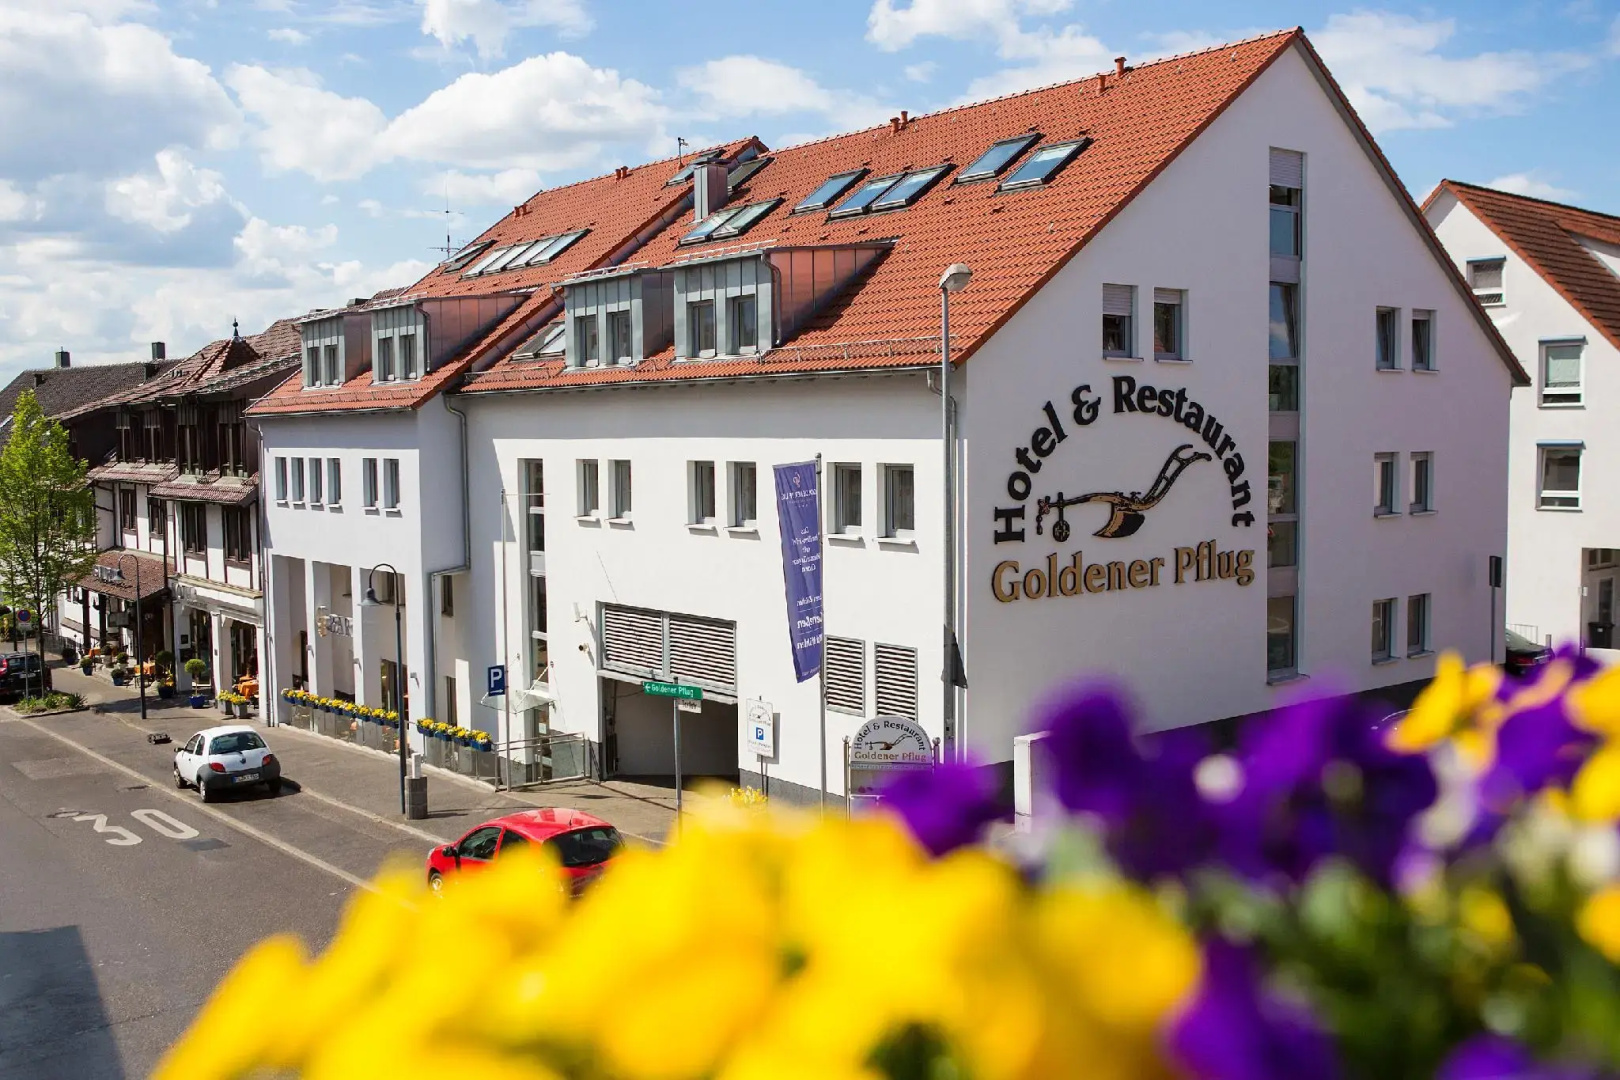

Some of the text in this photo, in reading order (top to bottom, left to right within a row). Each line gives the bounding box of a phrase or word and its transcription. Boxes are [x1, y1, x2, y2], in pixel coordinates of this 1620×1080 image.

[994, 375, 1255, 545] Hotel & Restaurant
[992, 539, 1255, 603] Goldener Pflug
[490, 668, 503, 688] P
[651, 684, 694, 698] Goldener Pflug
[757, 728, 763, 739] P
[854, 720, 926, 751] Hotel & Restaurant
[854, 751, 927, 763] Goldener Pflug
[72, 808, 200, 846] 30
